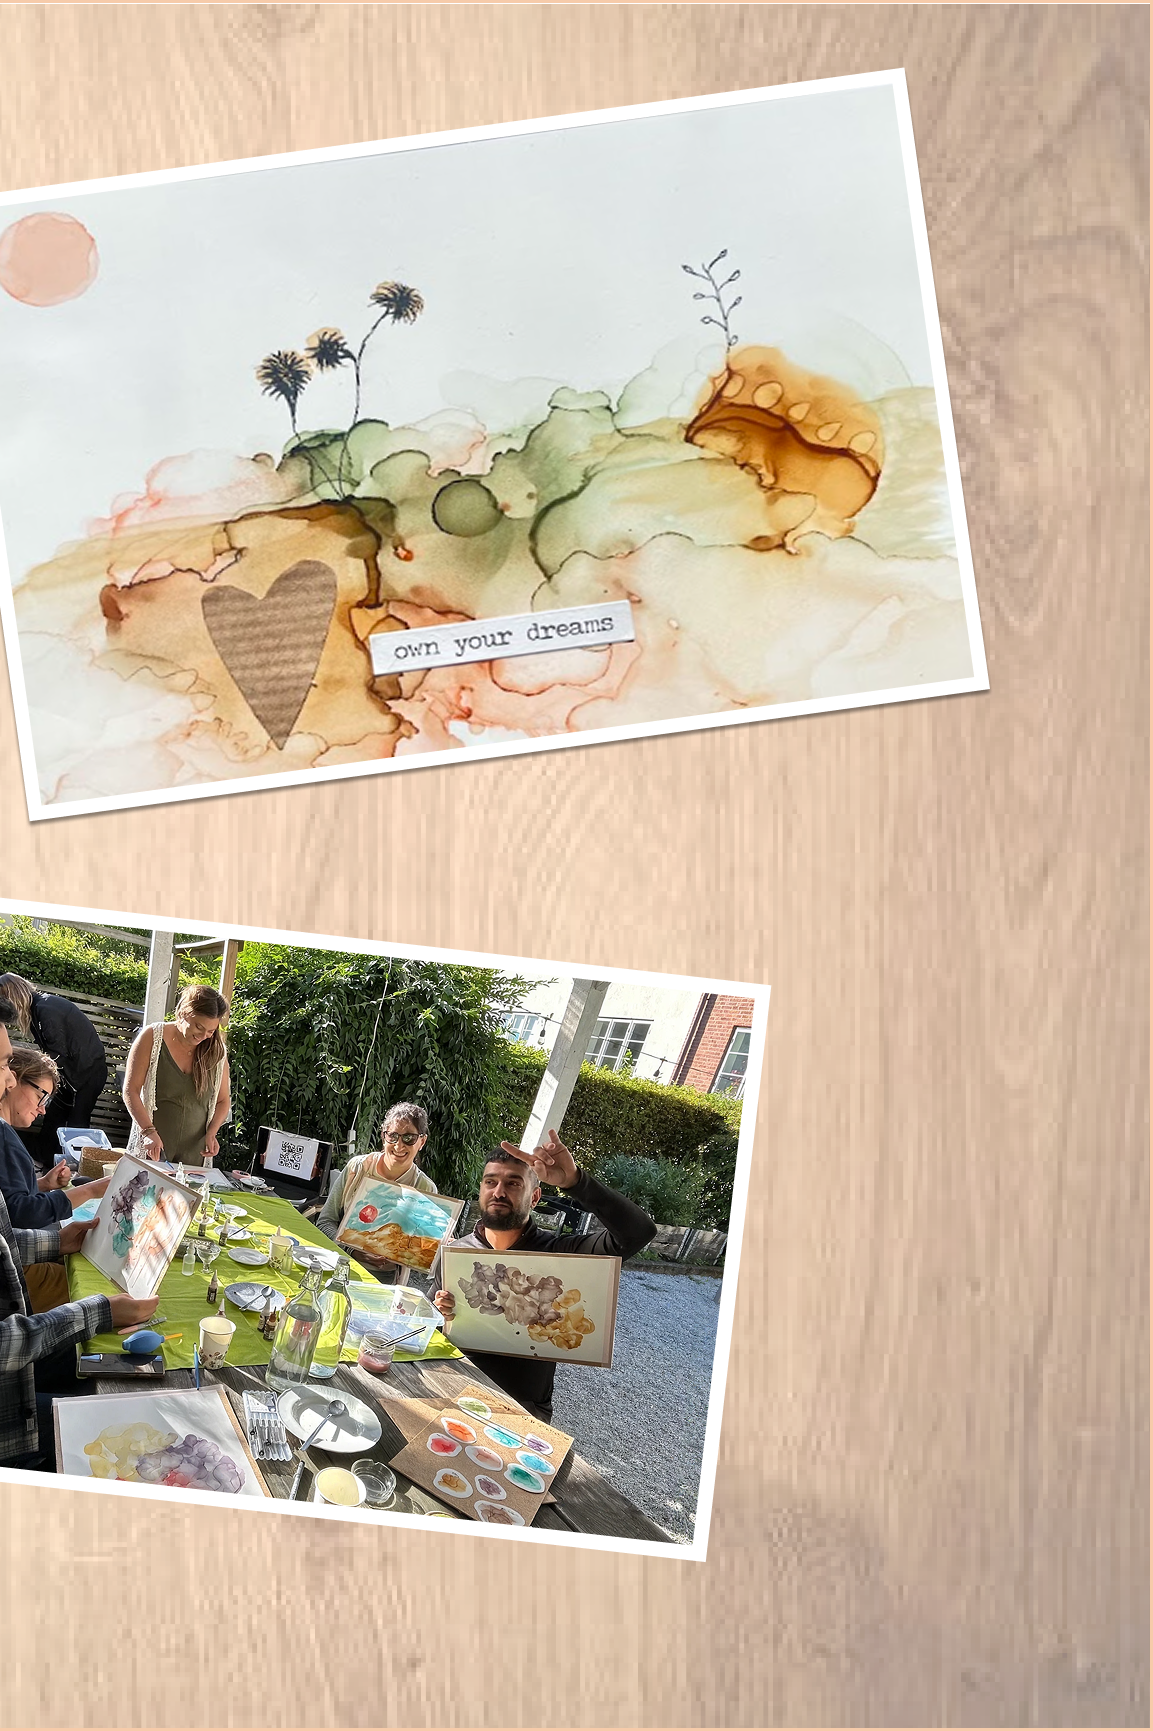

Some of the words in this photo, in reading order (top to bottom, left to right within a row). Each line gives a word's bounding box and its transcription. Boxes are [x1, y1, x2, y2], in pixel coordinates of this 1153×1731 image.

[394, 640, 441, 660] own
[454, 629, 513, 657] your
[526, 616, 615, 642] dreams
